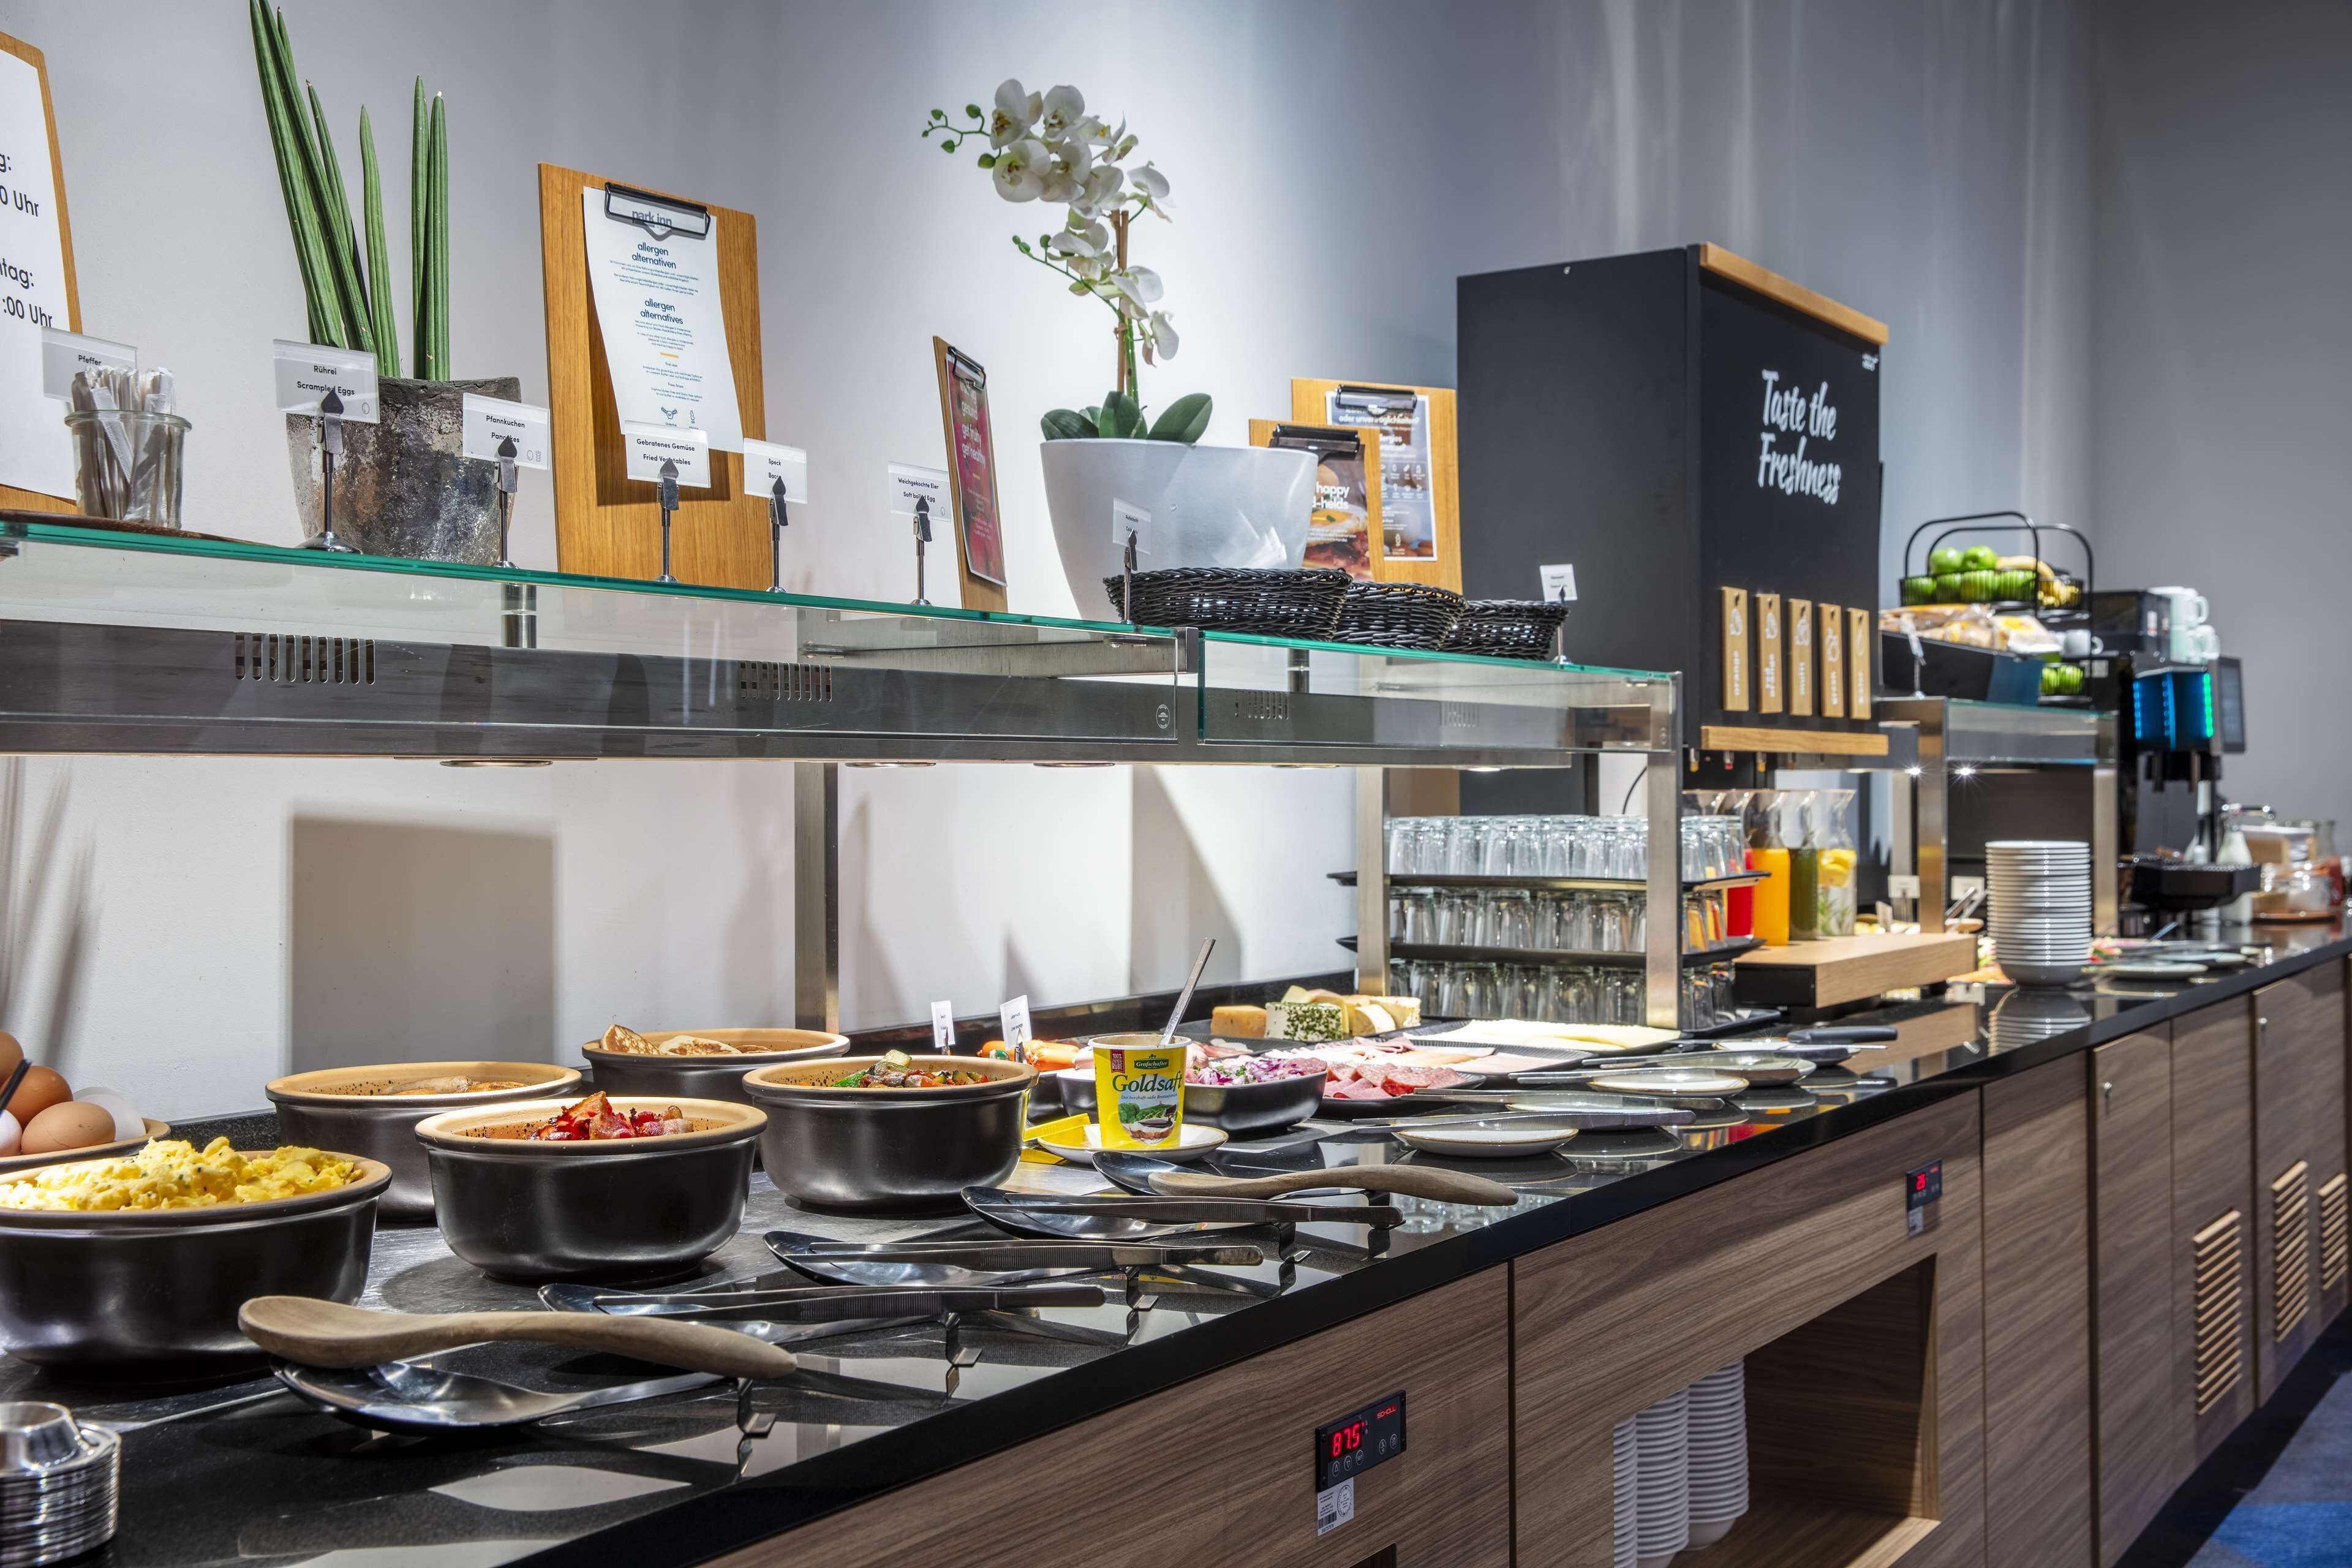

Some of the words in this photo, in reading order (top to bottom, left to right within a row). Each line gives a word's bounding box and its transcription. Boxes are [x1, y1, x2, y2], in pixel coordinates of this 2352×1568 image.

[13, 190, 39, 217] Uhr
[638, 242, 669, 257] allergen
[631, 253, 677, 270] alternativen
[644, 298, 676, 312] allergen
[29, 304, 53, 327] Uhr
[640, 309, 684, 325] alternatives
[78, 355, 102, 366] Pfeffer
[314, 365, 337, 375] Rührei
[337, 386, 355, 396] Eggs
[1762, 369, 1806, 432] Taste
[1809, 380, 1837, 441] the
[486, 415, 525, 428] Pfannkuchen
[491, 432, 520, 443] Panckes
[636, 439, 670, 448] Gebratenes
[671, 443, 695, 451] Gemüse
[1758, 431, 1842, 505] Freshness
[898, 478, 930, 488] Weichgekochte
[1316, 481, 1349, 498] happy
[1112, 1071, 1183, 1092] Goldsaft
[1377, 1406, 1397, 1420] SCHOLL
